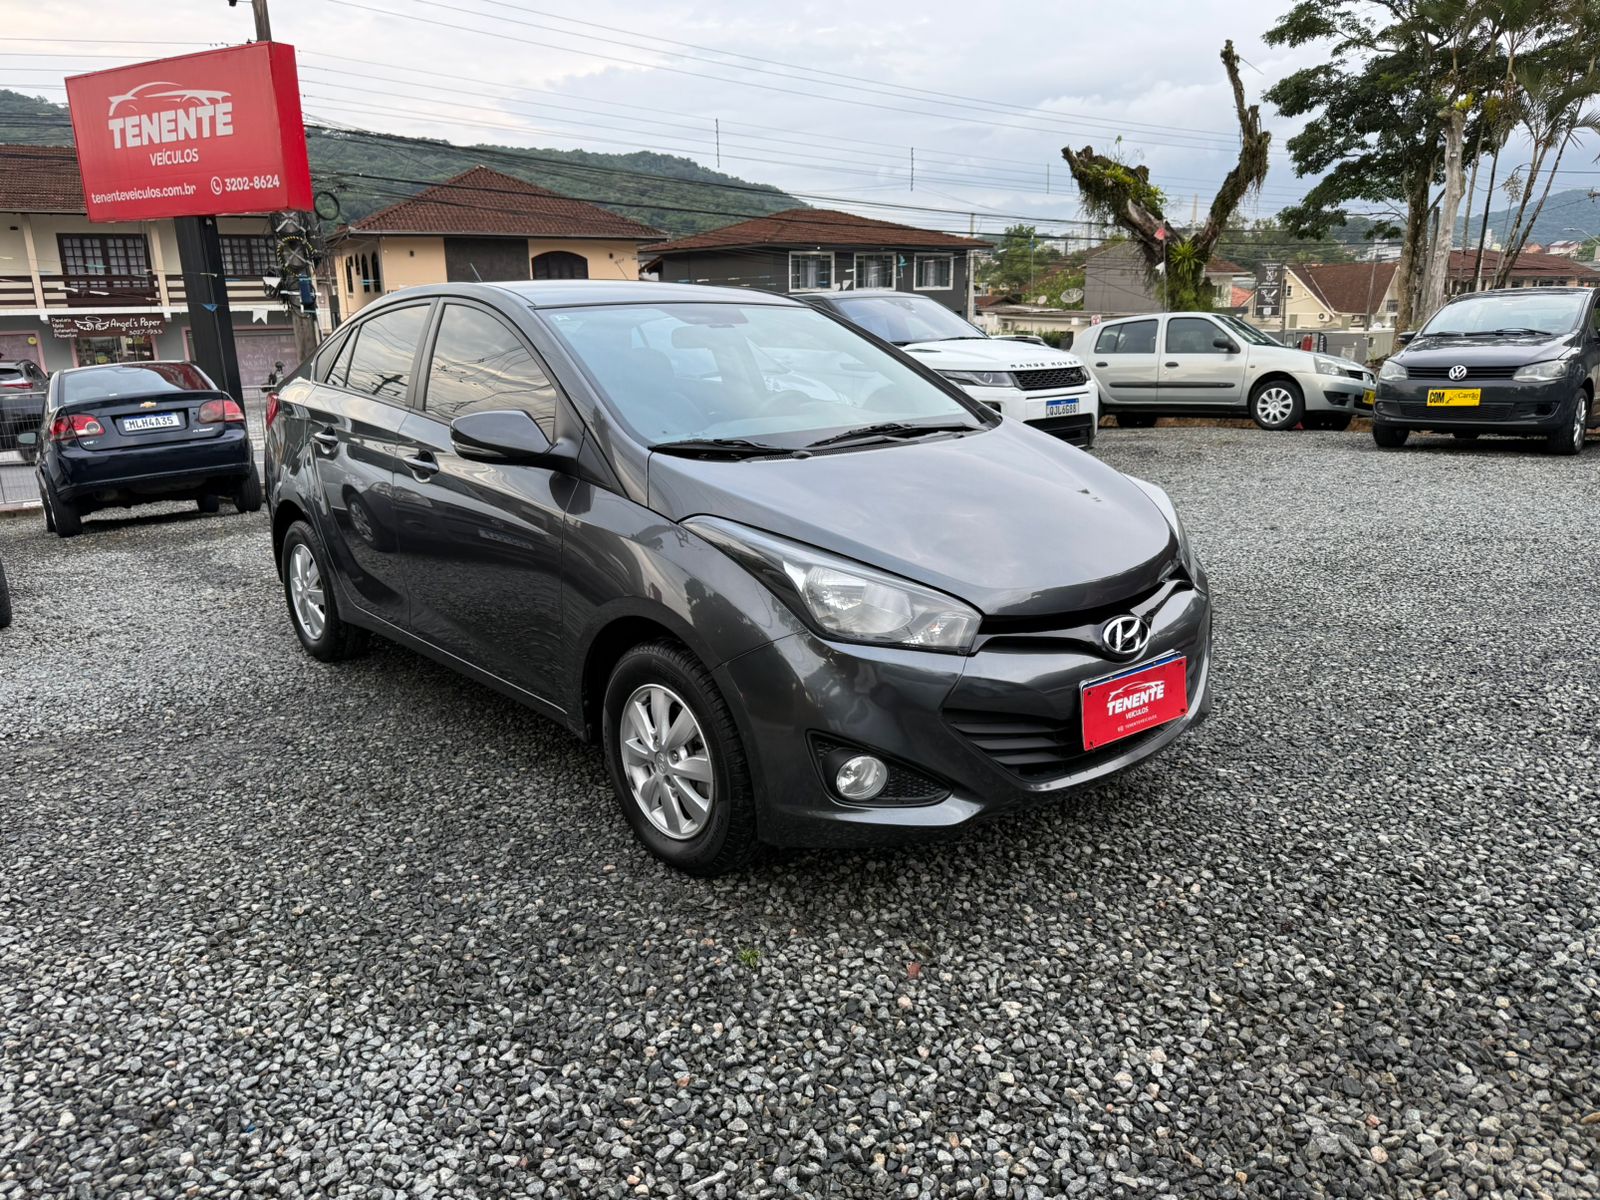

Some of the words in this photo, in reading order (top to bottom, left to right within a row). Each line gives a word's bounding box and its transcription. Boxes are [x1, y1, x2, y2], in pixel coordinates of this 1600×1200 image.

[108, 102, 234, 149] TENENTE
[149, 148, 199, 166] VEÍCULOS
[224, 174, 280, 192] 3202-8624
[91, 182, 196, 204] tenenteveiculos.com.br
[110, 318, 138, 332] Angel's
[140, 317, 161, 328] Paper
[1430, 392, 1445, 403] COM
[128, 417, 174, 429] MLH4A35
[1107, 684, 1165, 716] TENENTE
